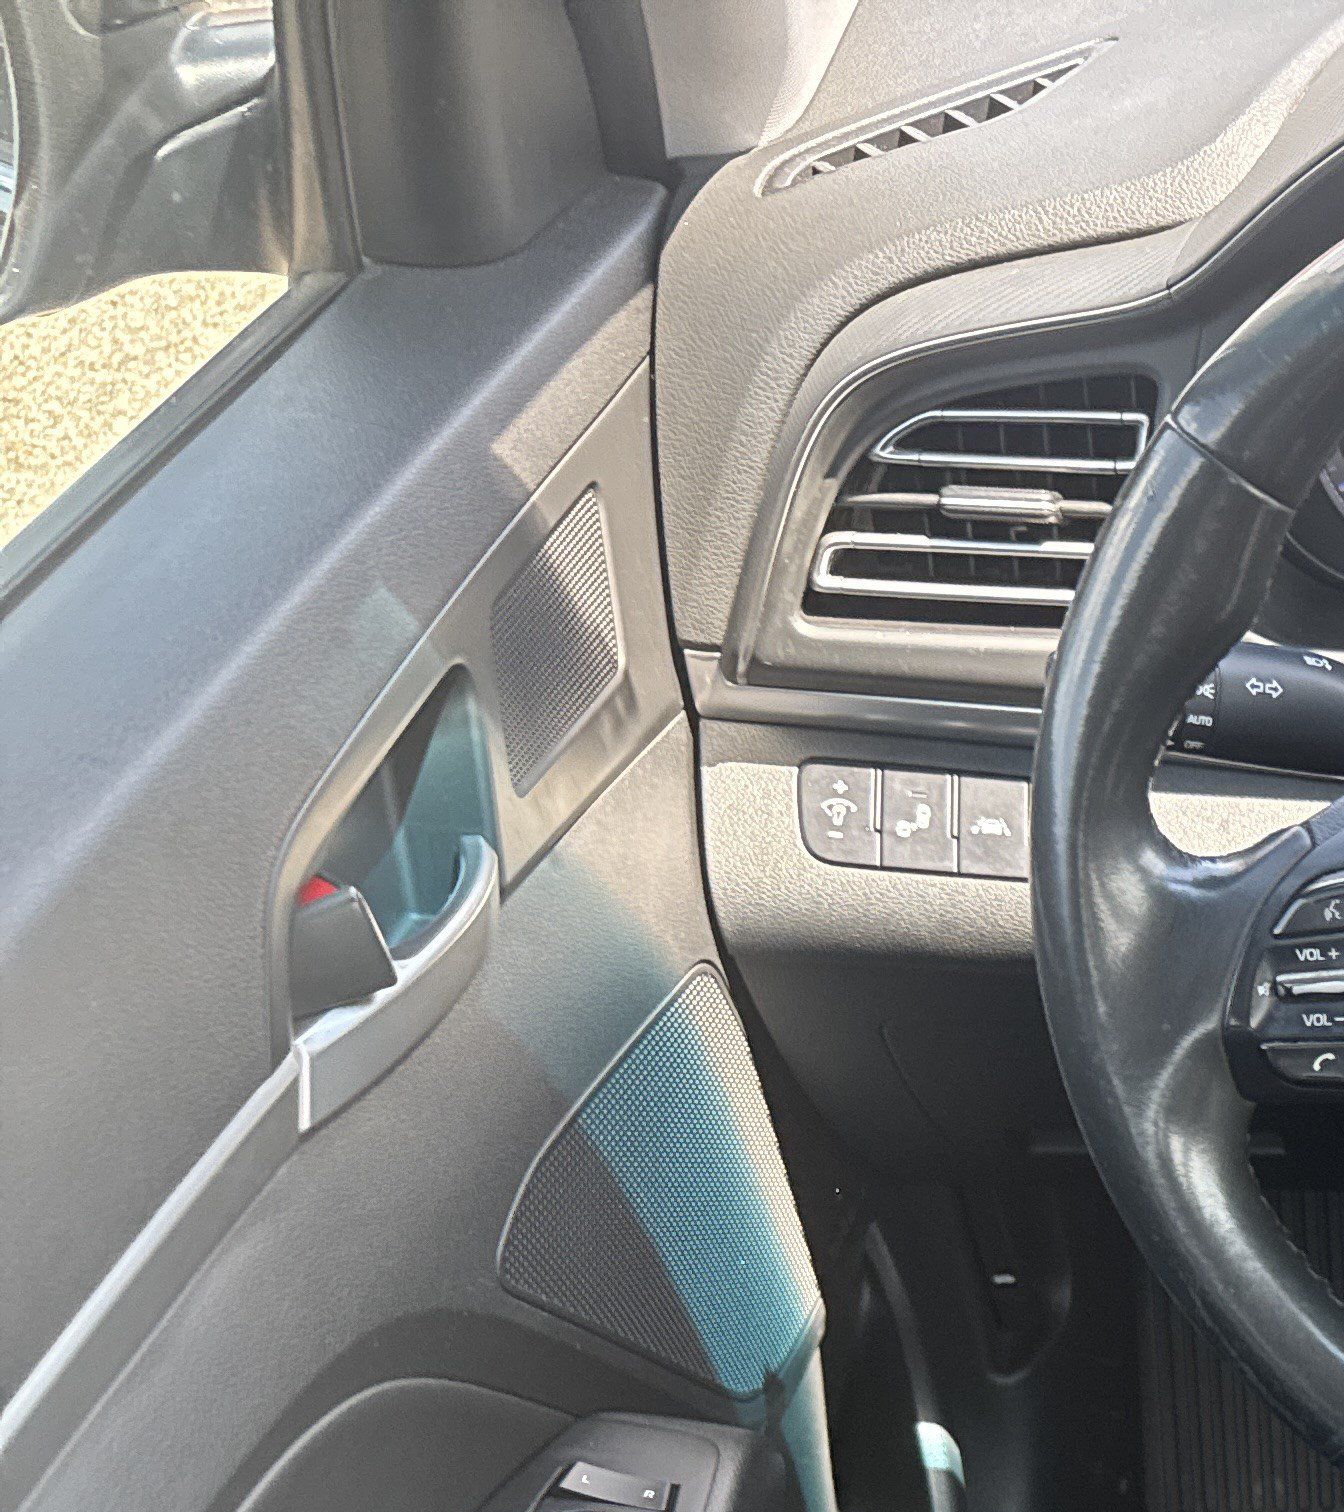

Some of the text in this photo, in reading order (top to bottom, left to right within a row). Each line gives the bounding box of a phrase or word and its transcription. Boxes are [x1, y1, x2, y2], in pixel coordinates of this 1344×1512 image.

[1187, 714, 1213, 727] AUTO
[1295, 948, 1325, 961] VOL
[1302, 1013, 1332, 1027] VOL
[581, 1475, 590, 1484] L
[643, 1490, 655, 1498] R
